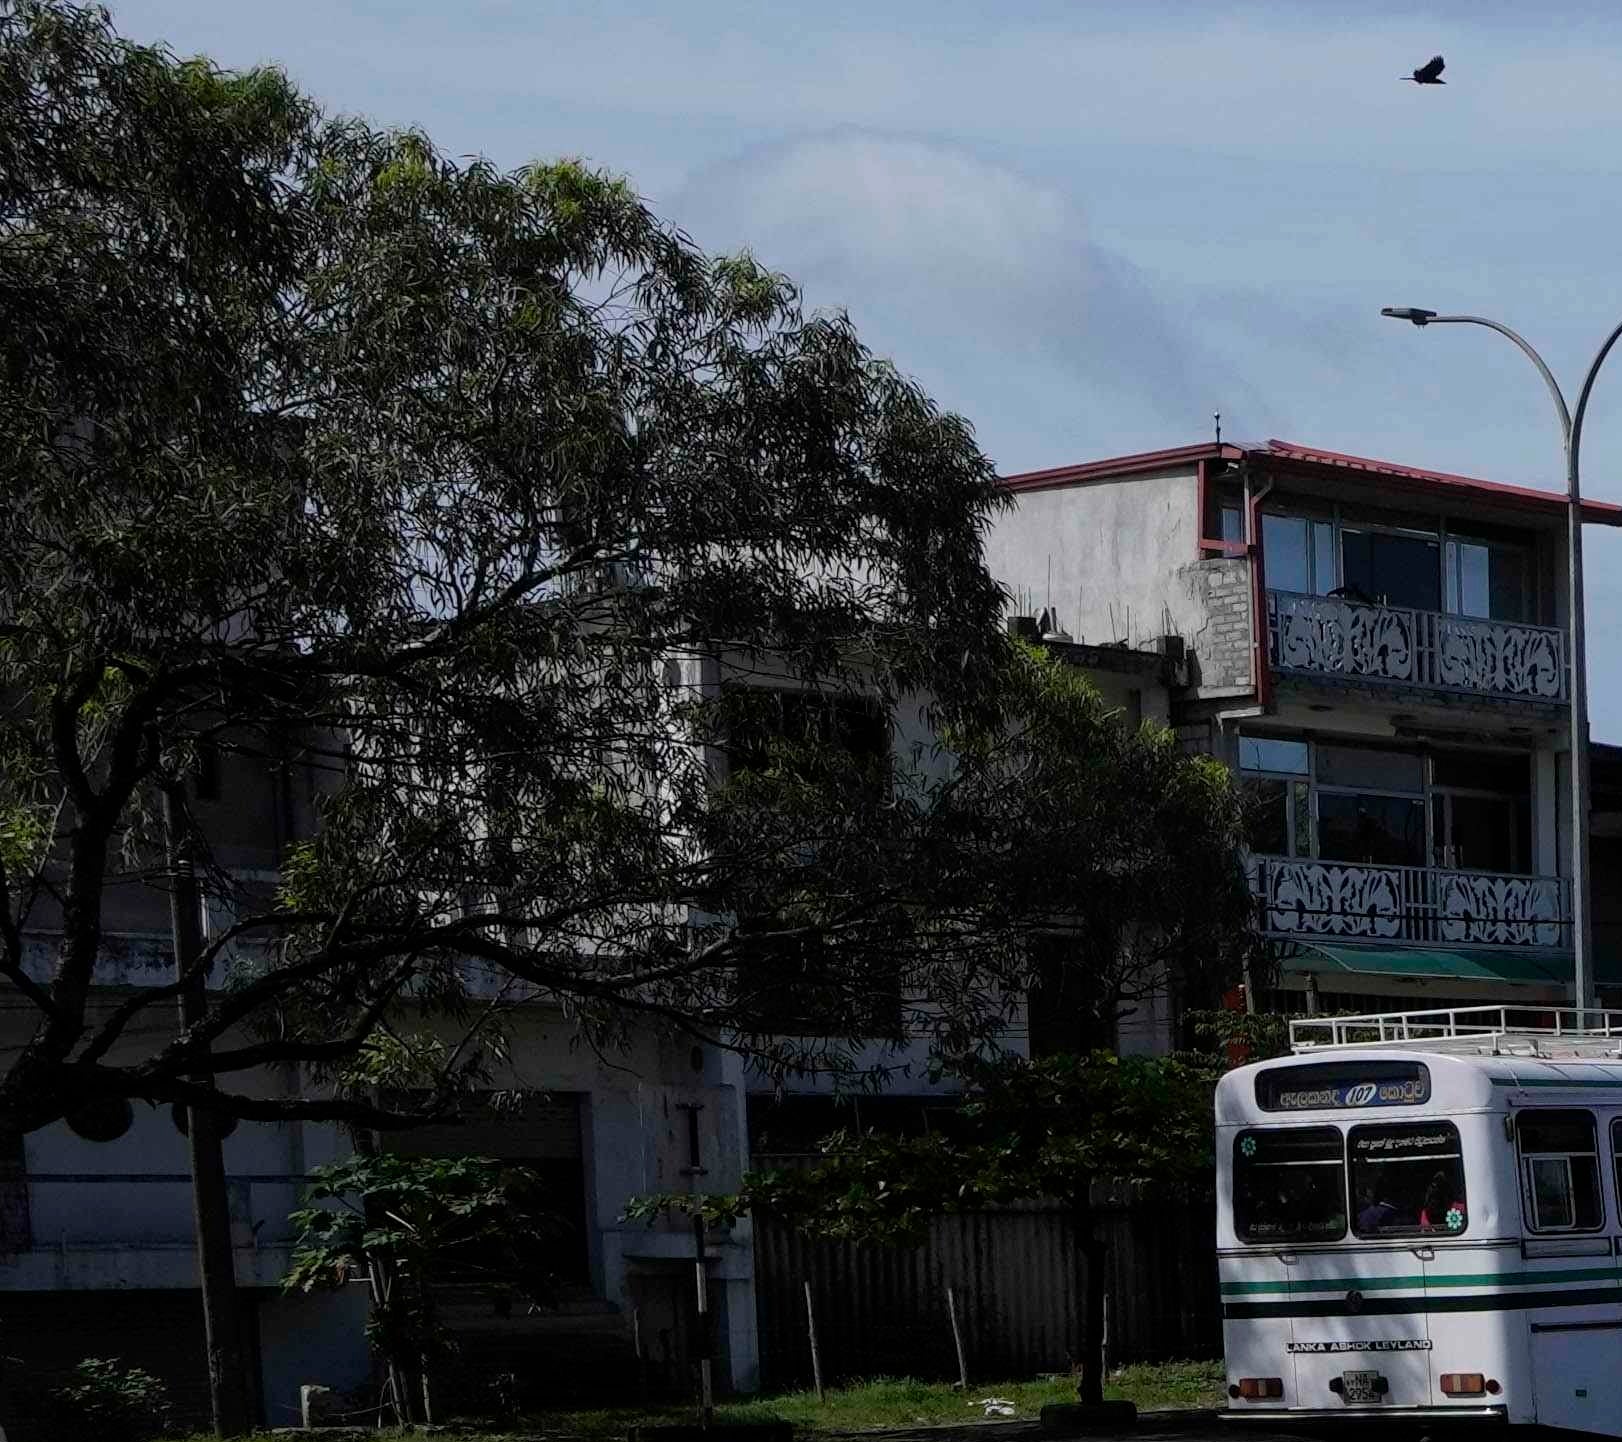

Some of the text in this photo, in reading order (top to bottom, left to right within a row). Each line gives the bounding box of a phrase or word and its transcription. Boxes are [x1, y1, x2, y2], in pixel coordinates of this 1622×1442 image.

[1350, 1086, 1373, 1104] 107
[1287, 1340, 1432, 1352] LANKA ASHOK LEYLAND
